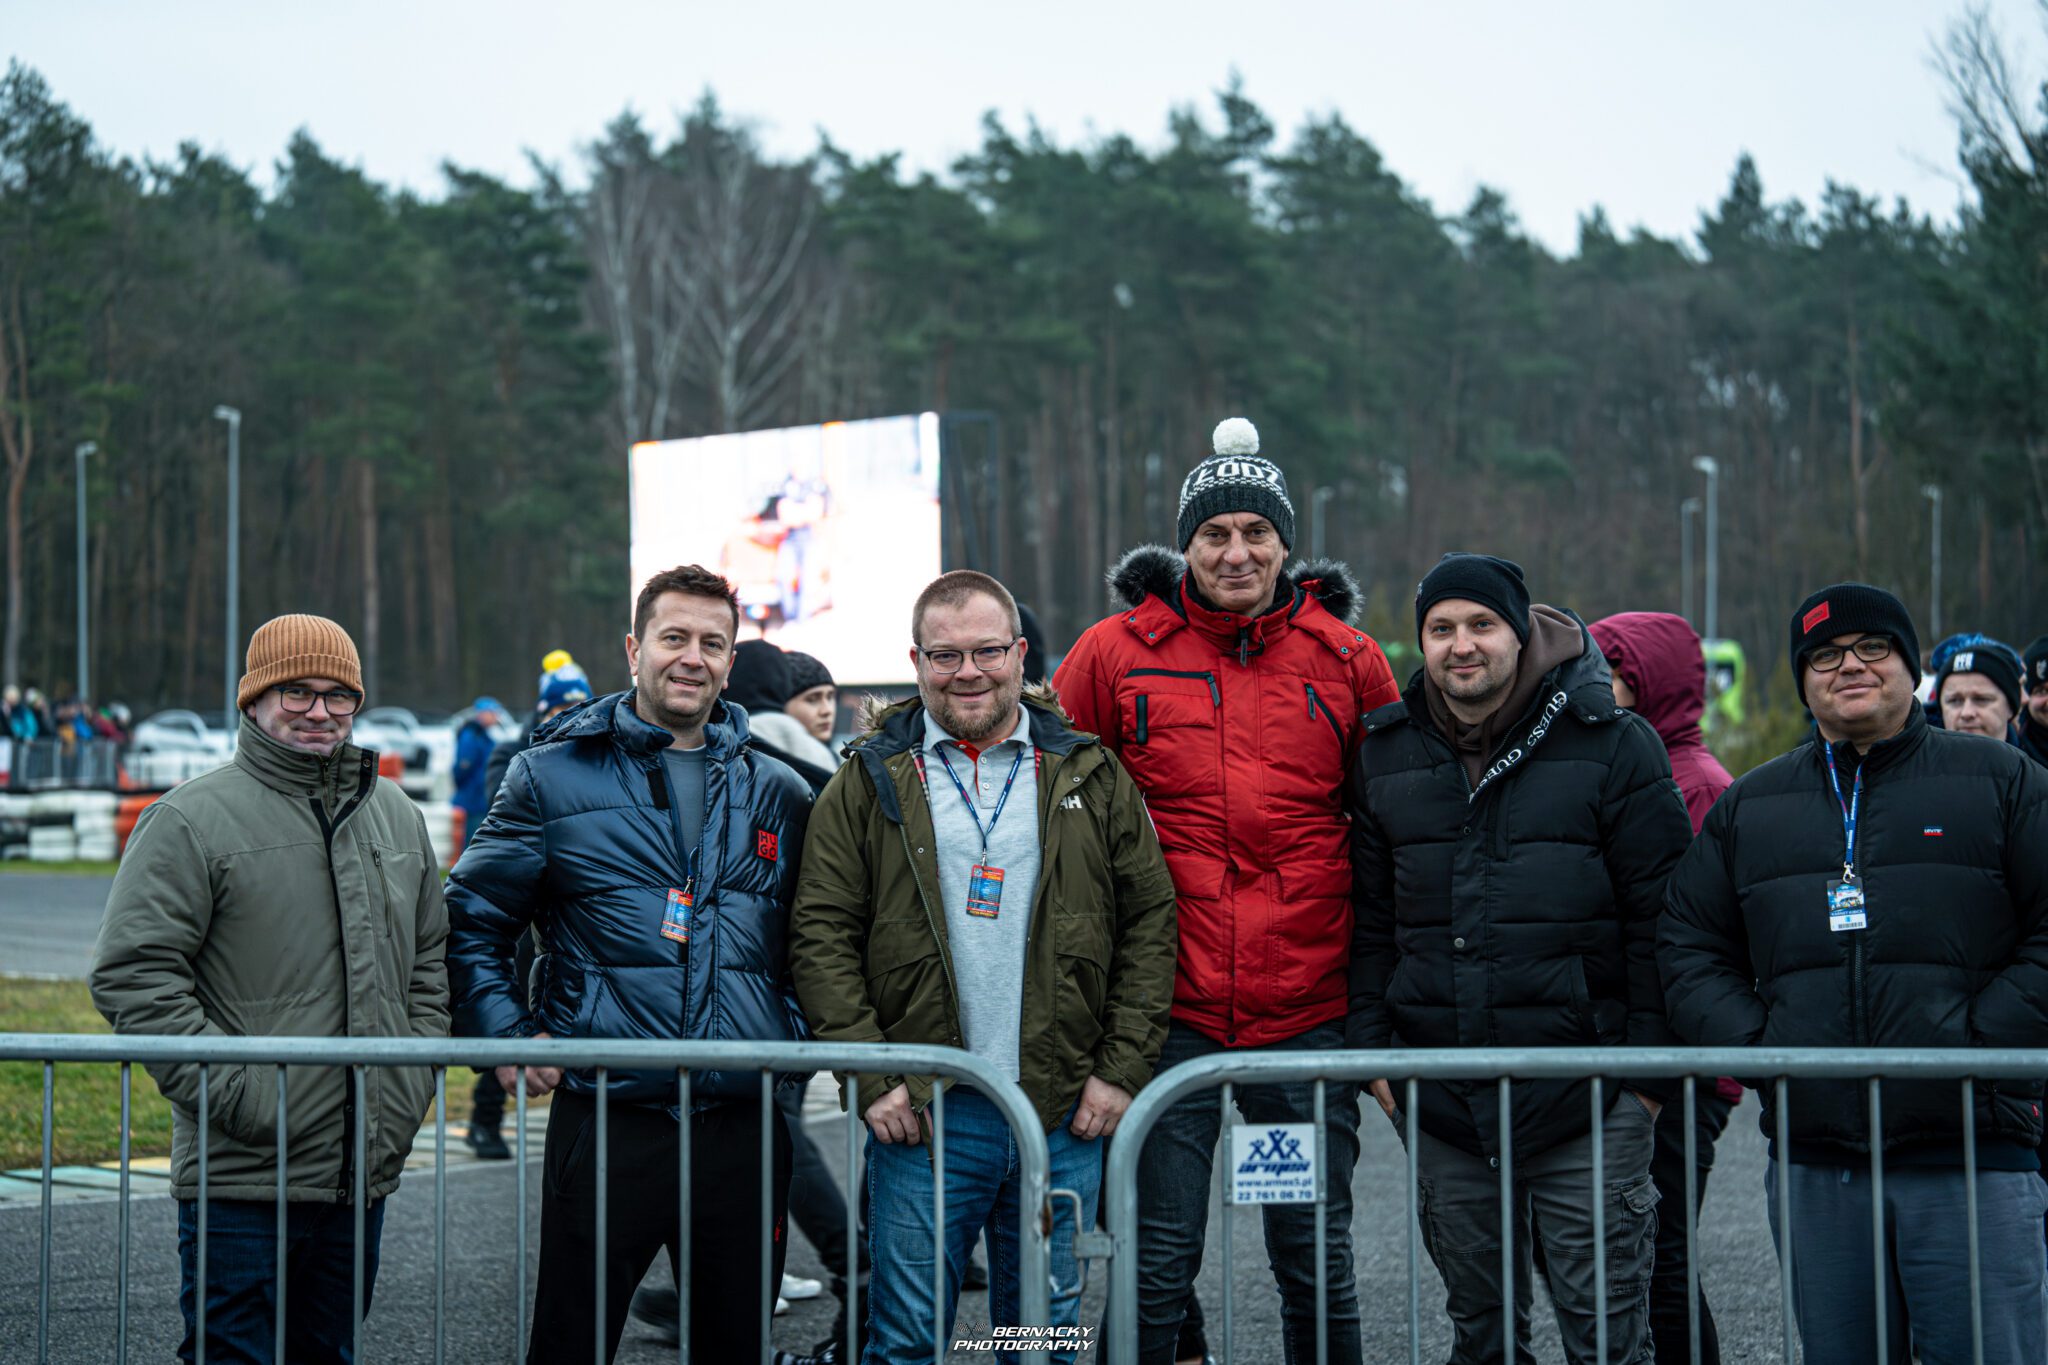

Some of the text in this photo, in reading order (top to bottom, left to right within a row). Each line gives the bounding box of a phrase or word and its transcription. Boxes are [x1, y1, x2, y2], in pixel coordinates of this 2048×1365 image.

[1527, 691, 1567, 747] GUESS
[1237, 1190, 1251, 1200] 22
[1255, 1190, 1275, 1200] 761
[1298, 1189, 1312, 1199] 70
